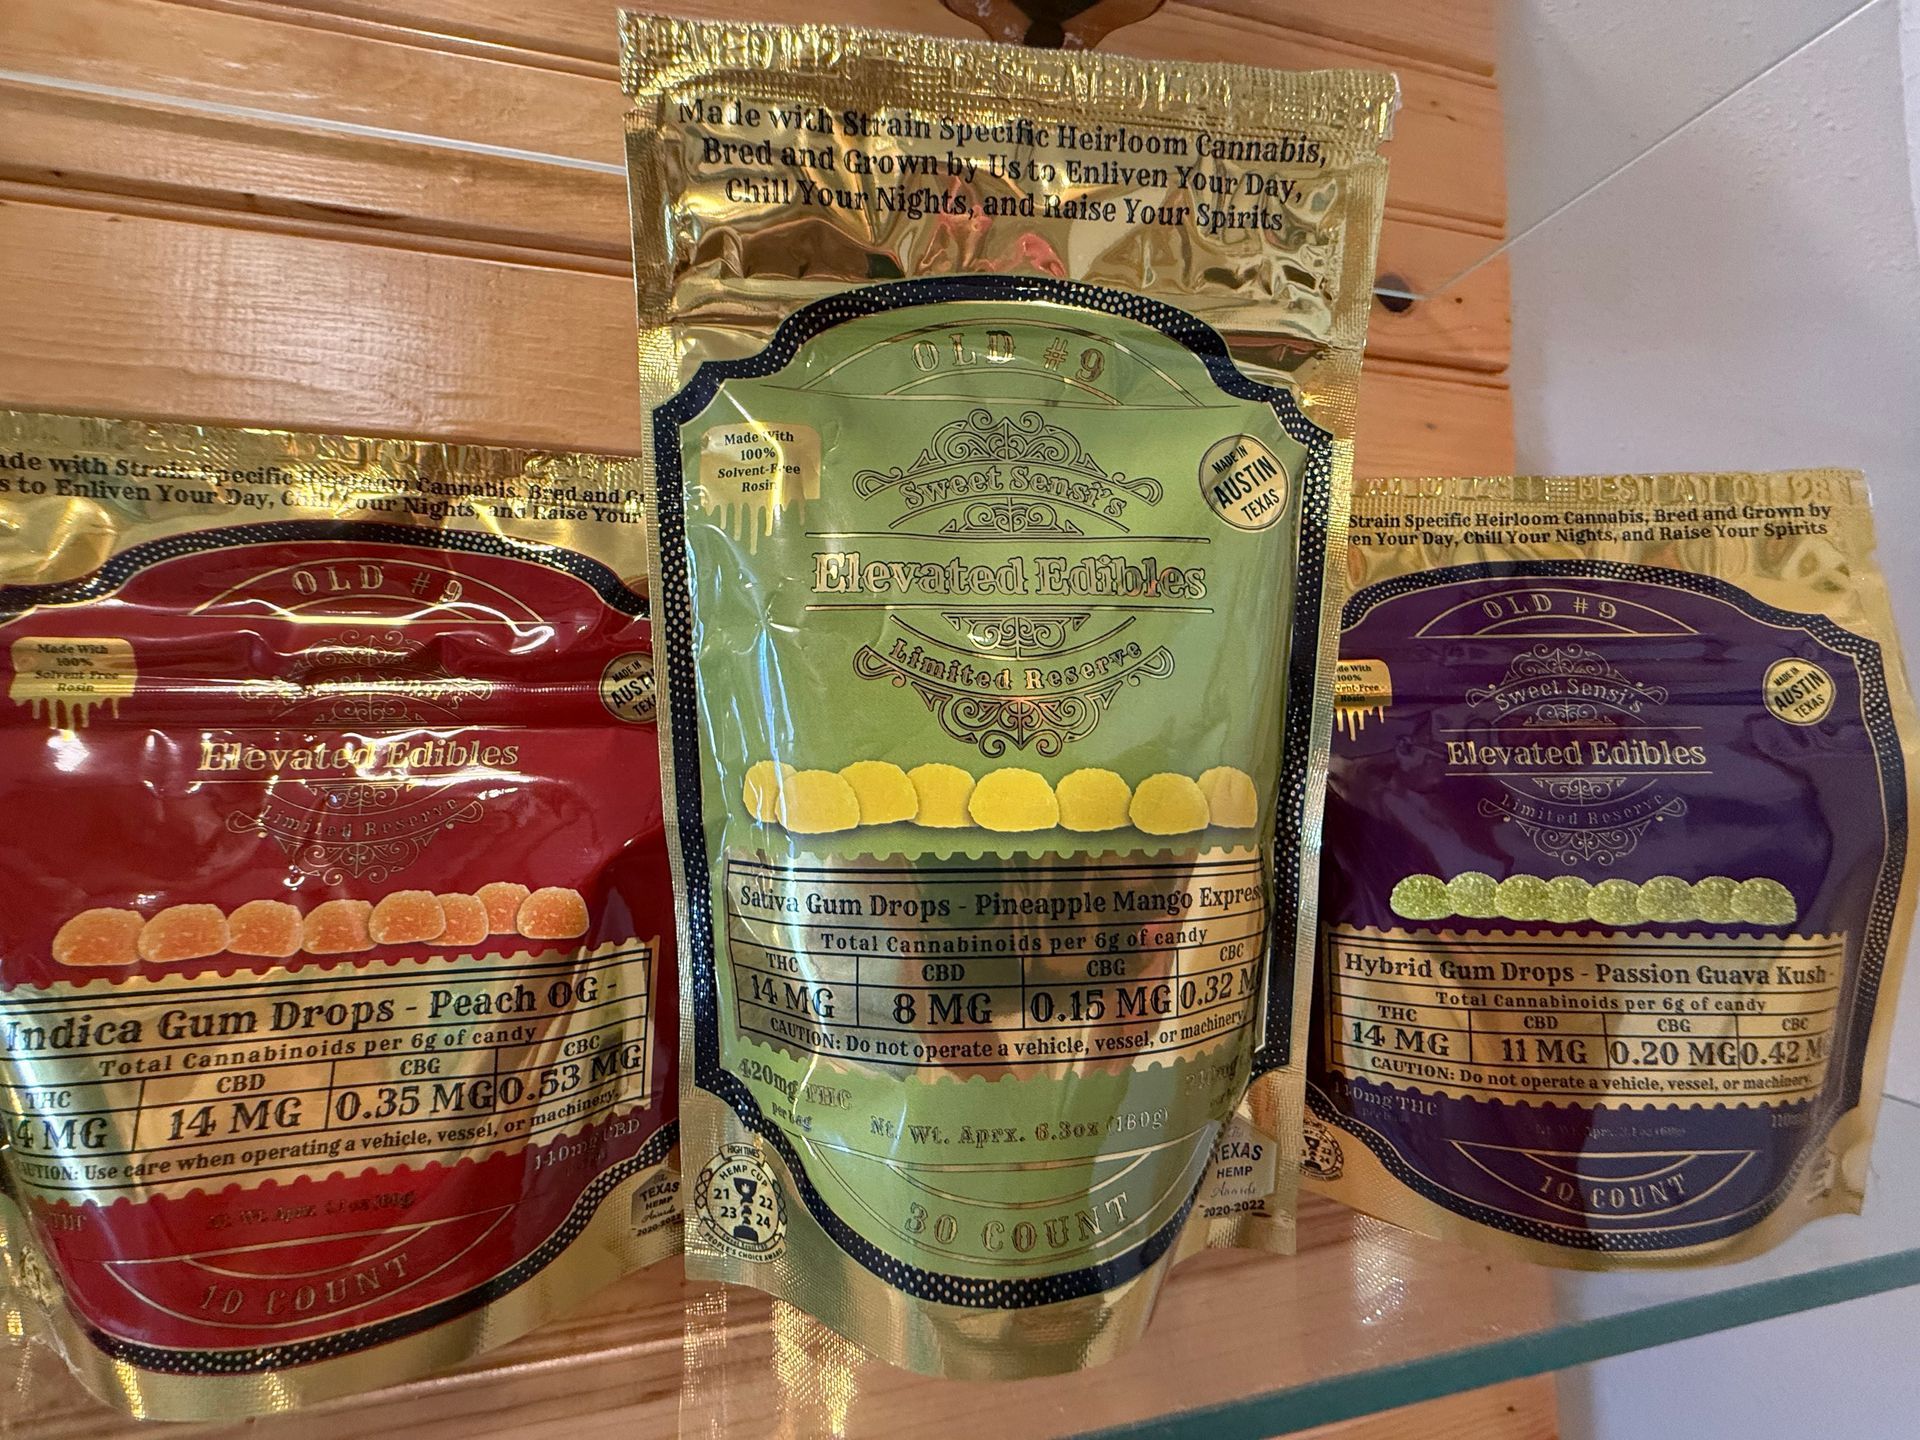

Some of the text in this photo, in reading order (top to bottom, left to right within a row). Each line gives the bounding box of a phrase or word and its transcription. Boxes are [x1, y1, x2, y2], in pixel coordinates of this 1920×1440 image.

[678, 98, 1326, 168] Made with Strain Specific Heirloom Cannabis,
[701, 137, 1302, 204] Bred and Grown by Us to Enliven Your Day,
[725, 178, 1283, 234] Chill Your Nights, and Raise Your Spirits
[911, 330, 1106, 383] OLD #9
[724, 432, 758, 445] Made
[740, 447, 776, 461] 100%
[1211, 445, 1248, 474] MADE IN
[899, 467, 1127, 518] Sweet Sensi's
[1213, 455, 1277, 509] AUSTIN
[1241, 488, 1280, 521] TEXAS
[1348, 502, 1831, 531] Strain Specific Heirloom Cannabis, Bred and Grown by
[1375, 532, 1418, 546] Your
[1422, 531, 1458, 549] Day,
[1463, 531, 1501, 545] Chill
[1506, 530, 1551, 544] Your
[1555, 528, 1618, 545] Nights,
[1621, 527, 1653, 542] and
[1659, 526, 1711, 540] Raise
[1715, 523, 1759, 539] Your
[1763, 520, 1828, 540] Spirits
[811, 551, 1207, 599] Elevated Edibles
[1482, 593, 1617, 619] OLD #9
[889, 638, 1142, 691] Limited Reserve
[1495, 678, 1642, 713] Sweet Sensi's
[1774, 670, 1825, 711] AUSTIN
[1793, 694, 1825, 718] TEXAS
[196, 737, 520, 772] Elevated Edibles
[1445, 739, 1707, 766] Elevated Edibles
[740, 886, 1193, 922] Sativa Gum Drops Pineapple Mango
[821, 926, 1208, 954] Total Cannabinoids per 6g of candy
[766, 952, 799, 972] THC
[922, 963, 965, 982] CBD
[1087, 959, 1125, 976] CBG
[1344, 952, 1826, 986] Hybrid Gum Drops Passion Guava Kush
[751, 975, 835, 1019] 14 MG
[1030, 984, 1172, 1022] 0.15 MG
[1180, 971, 1233, 1009] 0.32
[5, 976, 598, 1051] Indica Gum Drops Peach OG
[892, 993, 993, 1025] 8 MG
[1378, 1005, 1417, 1022] THC
[1523, 1015, 1558, 1029] CBD
[770, 1017, 1177, 1062] CAUTION: Do not operate vehicle, vessel, or
[1352, 1022, 1450, 1056] 14 MG
[1657, 1018, 1691, 1032] CBG
[99, 1026, 537, 1077] Total Cannabinoids per 6g of candy
[563, 1035, 600, 1057] CBC
[1502, 1038, 1588, 1064] 11 MG
[1610, 1041, 1737, 1066] 0.20 MG
[400, 1058, 440, 1076] CBG
[500, 1044, 642, 1105] 0.53 MG
[216, 1073, 265, 1094] CBD
[25, 1090, 72, 1110] THC
[336, 1079, 494, 1121] 0.35 MG
[43, 1117, 108, 1150] MG
[168, 1096, 303, 1142] 14 MG
[84, 1088, 619, 1181] Use care when operating vehicle, vessel, or machinery.
[719, 1164, 768, 1188] HEMP CUP
[1217, 1166, 1253, 1179] HEMP
[639, 1181, 680, 1201] TEXAS
[713, 1188, 730, 1200] 21
[759, 1194, 774, 1211] 22
[720, 1206, 737, 1219] 23
[756, 1213, 771, 1229] 24
[905, 1191, 1129, 1253] 30 COUNT
[1203, 1200, 1265, 1218] 2020-2022
[704, 1231, 736, 1256] PEOPLE'S
[738, 1251, 763, 1262] CHOICE
[764, 1247, 783, 1261] AWARD
